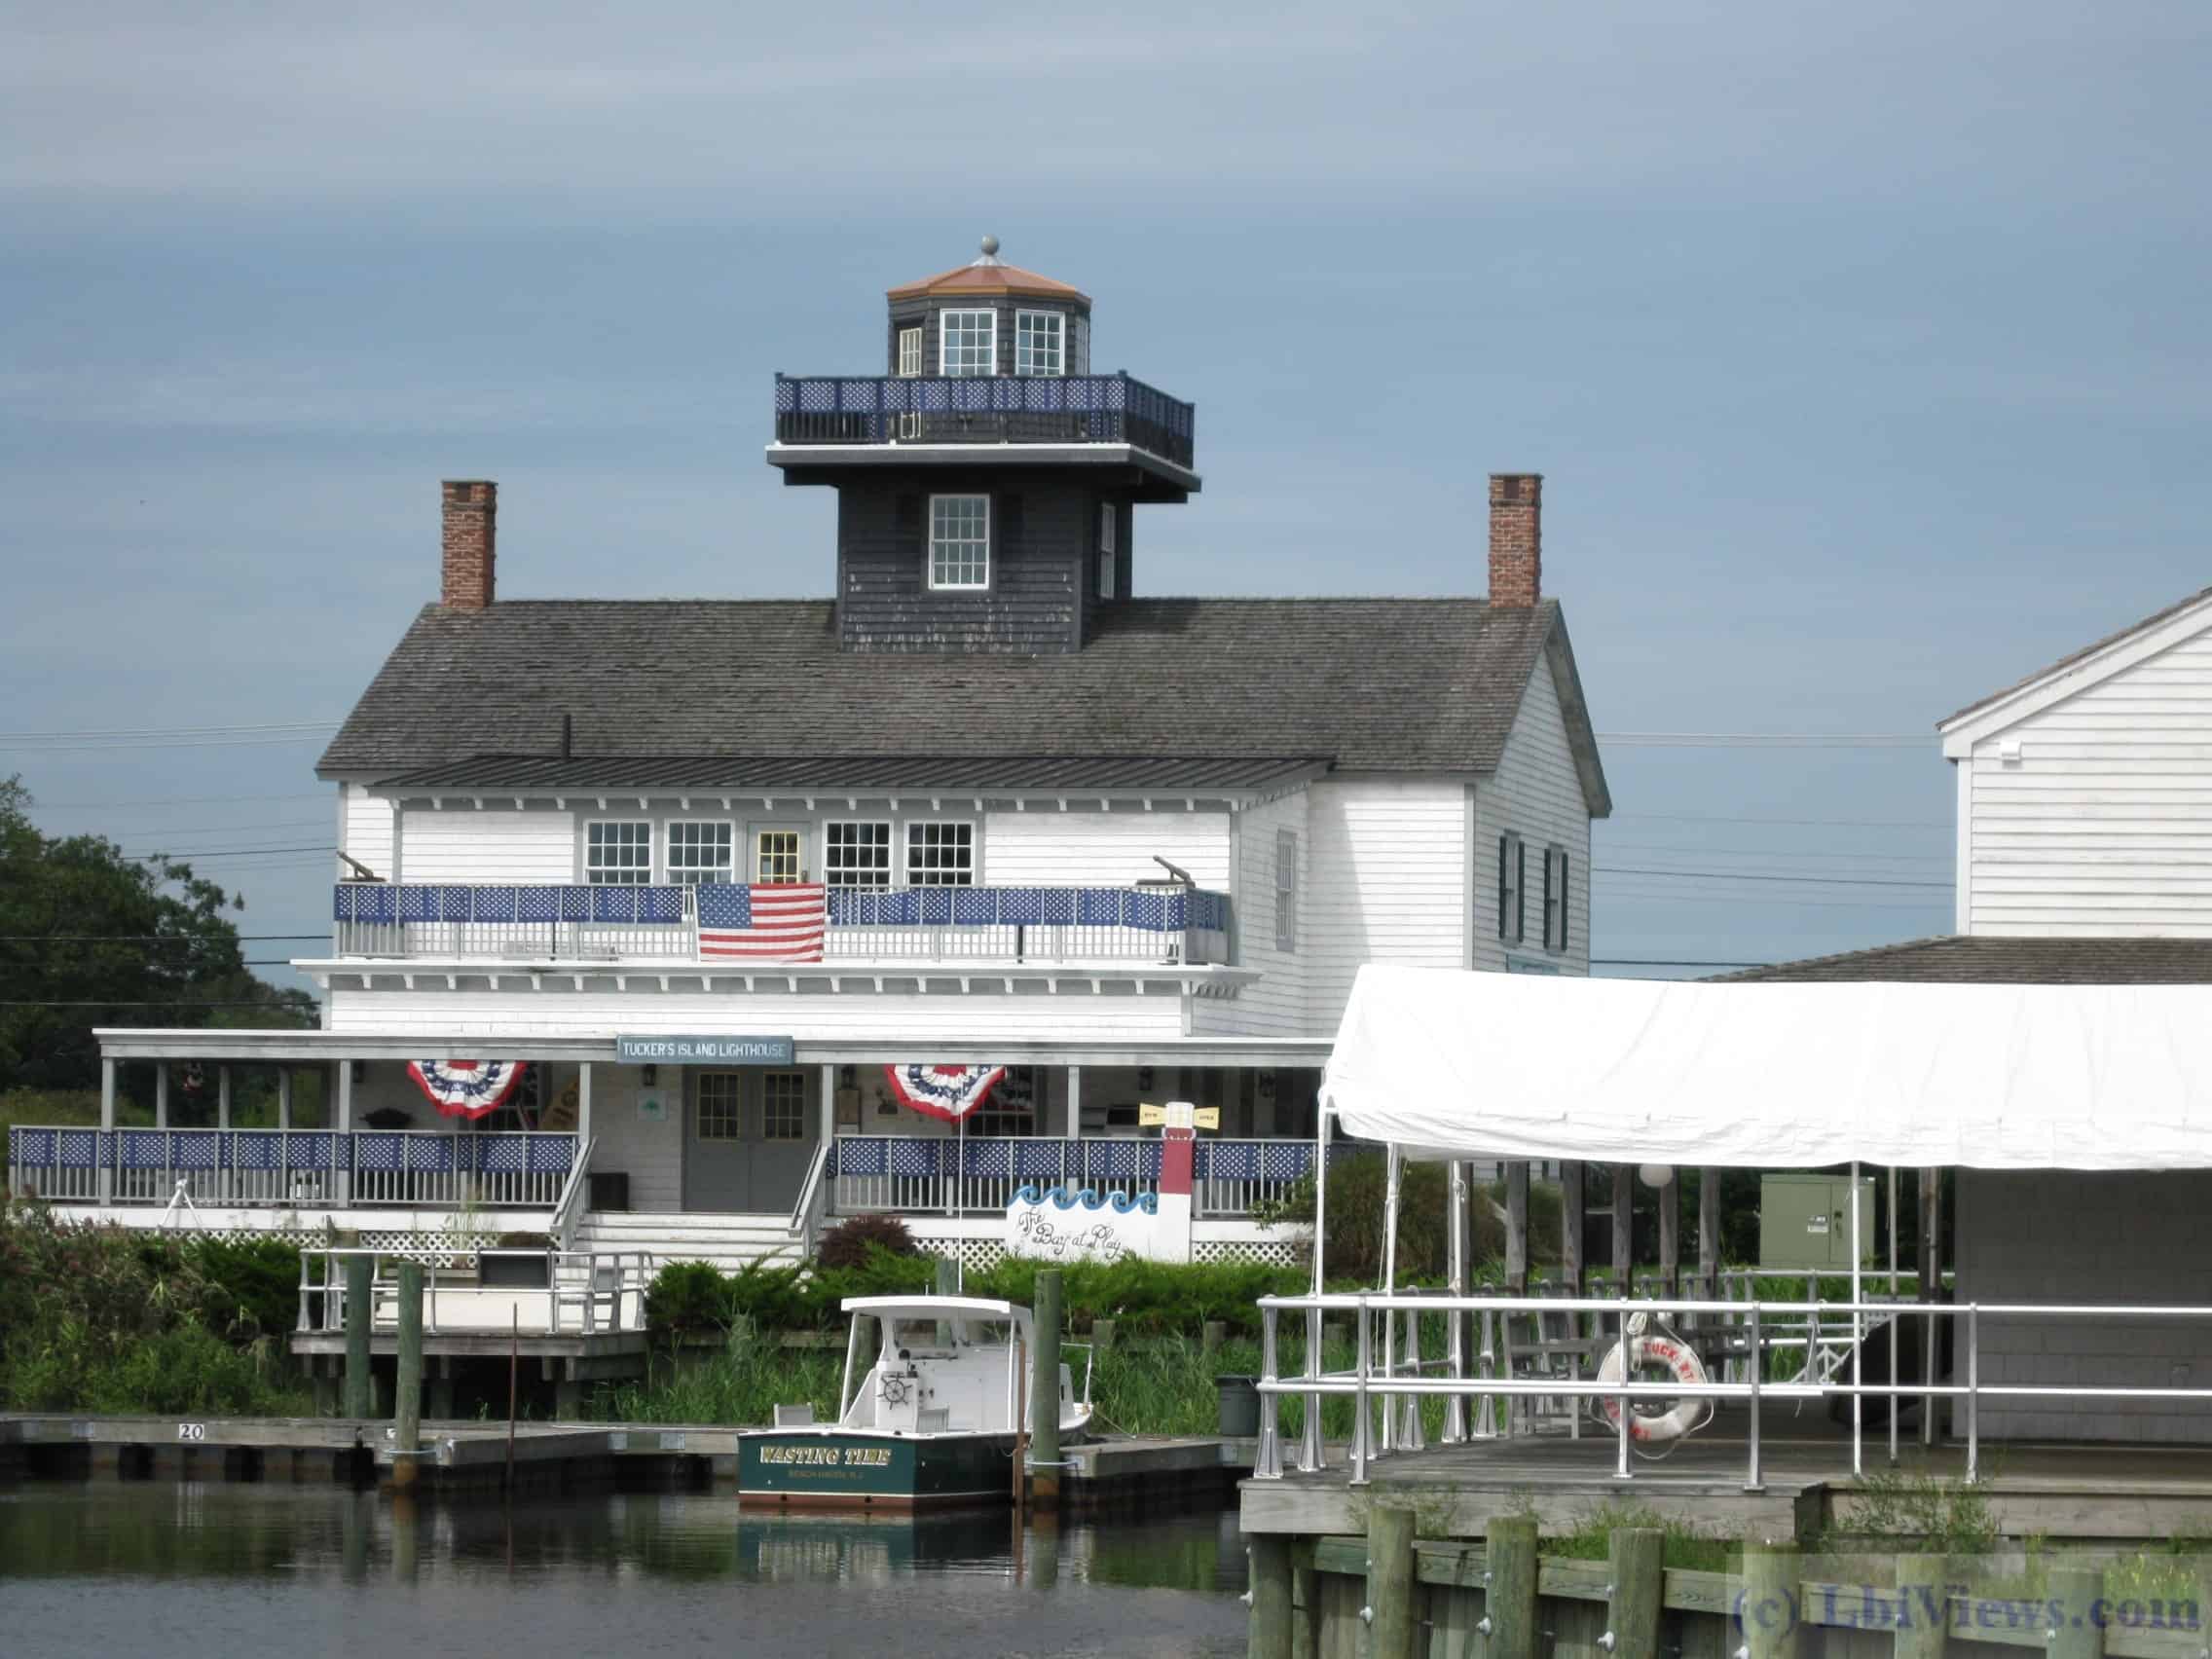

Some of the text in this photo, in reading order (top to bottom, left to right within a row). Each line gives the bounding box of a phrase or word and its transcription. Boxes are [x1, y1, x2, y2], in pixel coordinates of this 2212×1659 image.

[623, 1043, 787, 1058] TUCKER'S ISLAND LIGHTHOUSE
[1018, 1207, 1045, 1235] The
[1032, 1223, 1122, 1260] Bay at Play
[181, 1424, 203, 1440] 20
[759, 1446, 892, 1465] WASTING TIME
